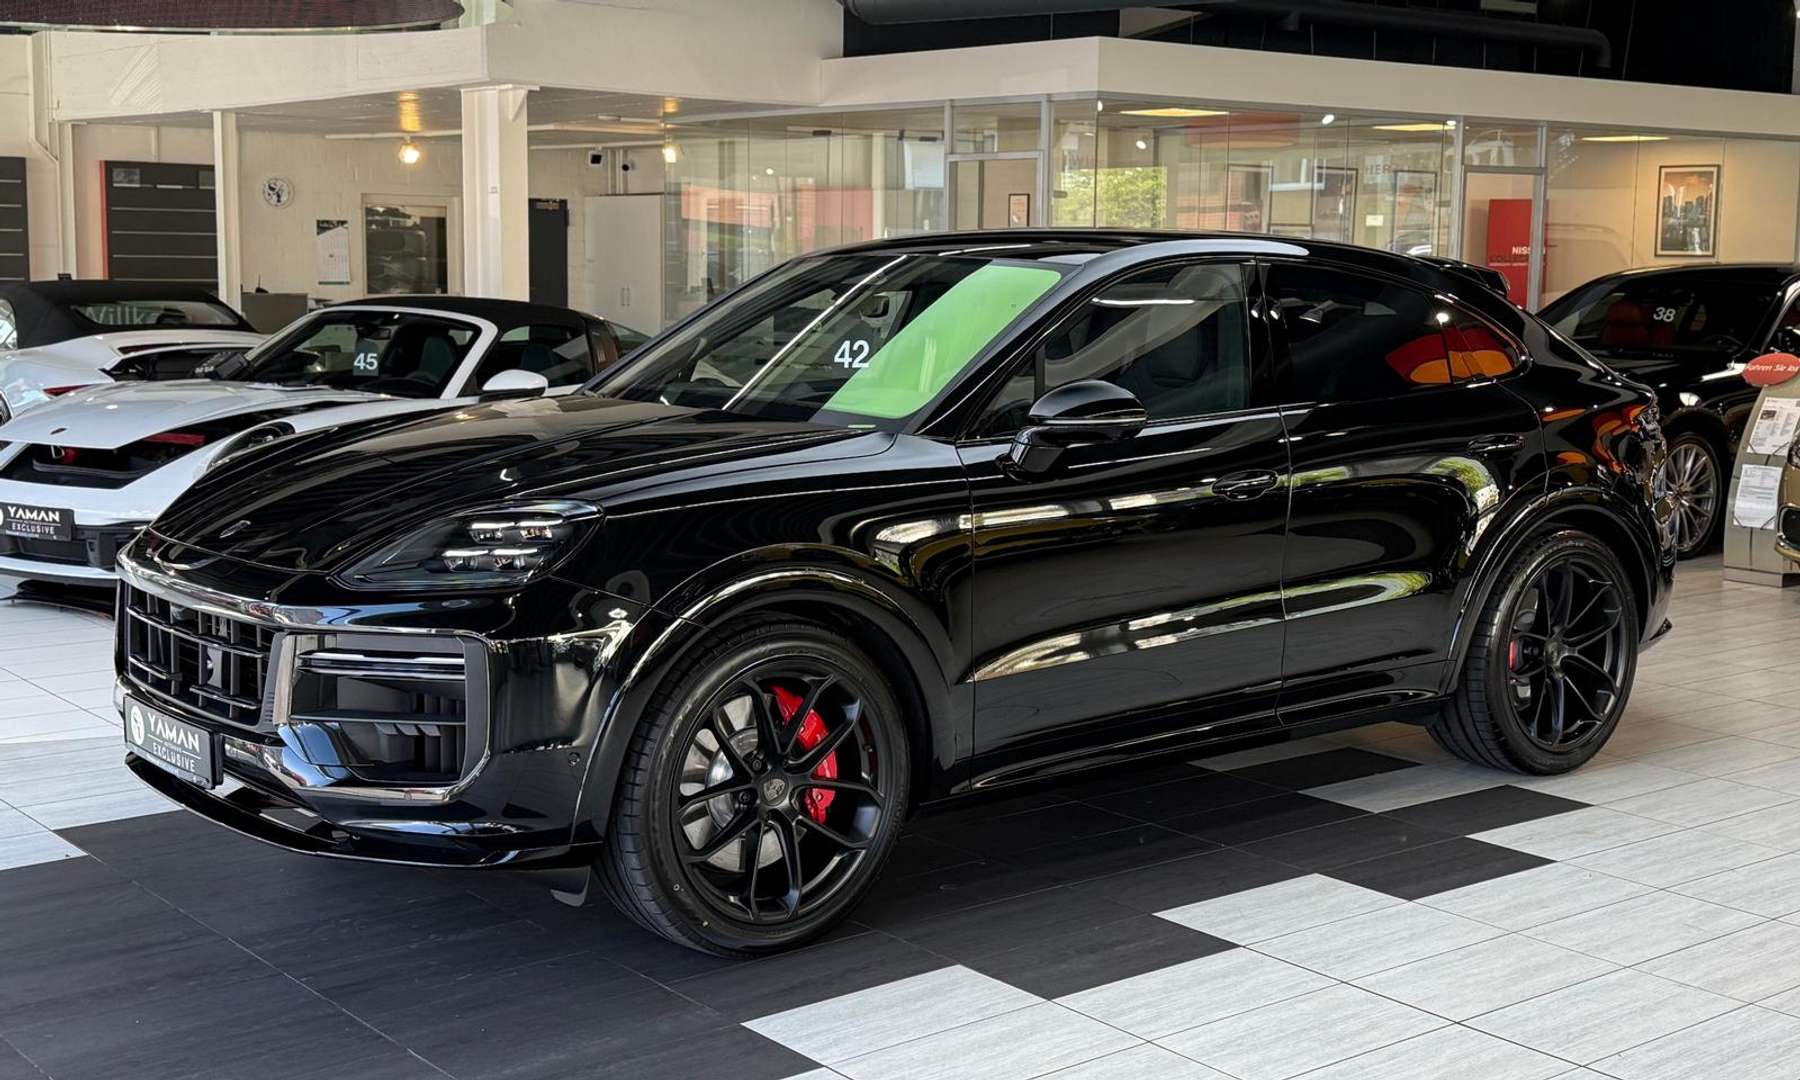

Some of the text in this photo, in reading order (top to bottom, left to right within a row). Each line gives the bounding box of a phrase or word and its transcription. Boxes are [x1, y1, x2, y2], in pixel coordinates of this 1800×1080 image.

[1653, 306, 1677, 322] 38
[353, 352, 378, 370] 45
[834, 340, 870, 369] 42
[7, 505, 60, 522] YAMAN
[11, 522, 55, 535] EXCLUSIVE
[147, 711, 200, 753] YAMAN
[152, 742, 196, 773] EXCLUSIVE
